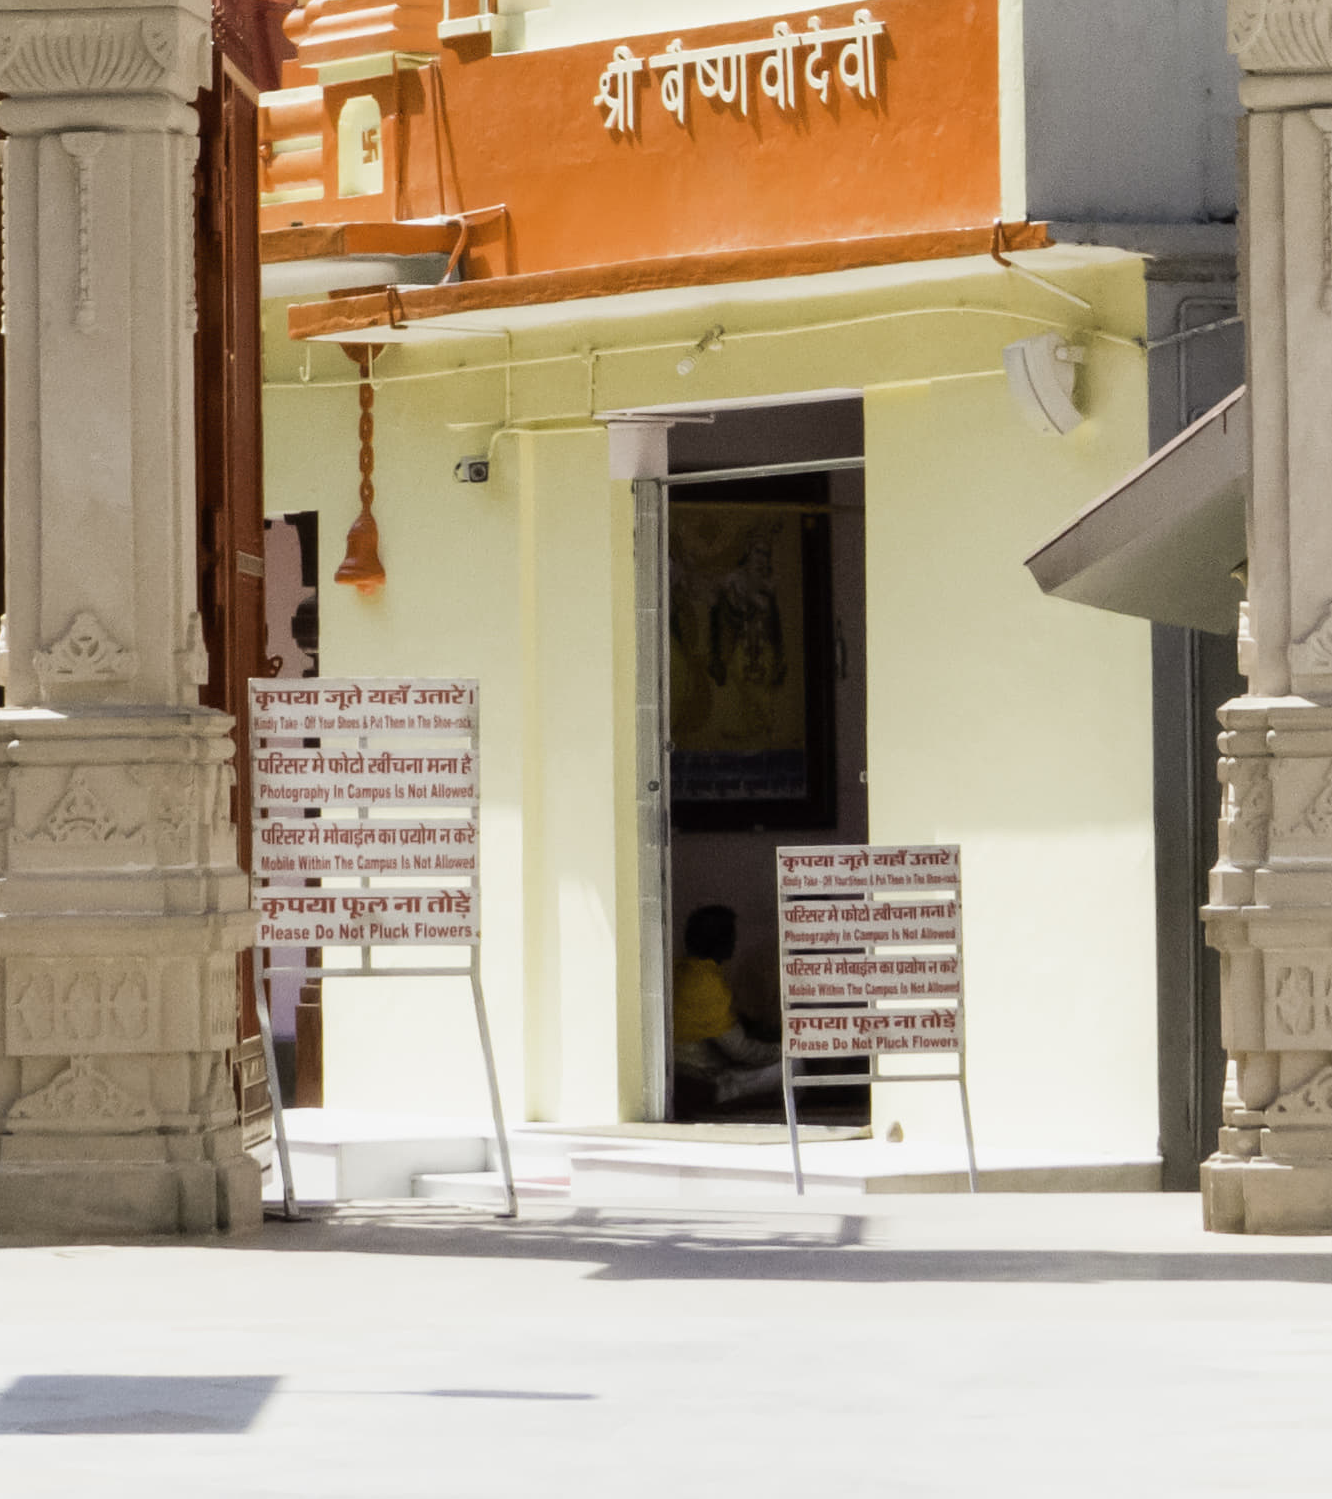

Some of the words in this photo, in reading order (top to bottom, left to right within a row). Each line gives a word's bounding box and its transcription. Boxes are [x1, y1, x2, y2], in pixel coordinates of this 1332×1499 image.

[593, 45, 644, 132] श्री
[254, 690, 320, 711] कृपया
[323, 684, 363, 711] जूते
[280, 715, 298, 729] Take
[385, 715, 406, 729] Them
[417, 715, 431, 729] The
[257, 751, 308, 774] परिसर
[328, 751, 364, 773] फोटो
[426, 758, 458, 773] मना
[461, 752, 472, 774] है
[260, 783, 330, 803] Photography
[334, 783, 344, 798] In
[348, 783, 391, 803] Campus
[395, 783, 404, 798] Is
[408, 783, 427, 798] Not
[431, 783, 474, 798] Allowed
[261, 821, 306, 845] परिसर
[378, 829, 396, 844] का
[400, 822, 436, 846] प्रयोग
[440, 829, 450, 844] न
[261, 855, 295, 870] Mobile
[298, 855, 331, 870] Within
[334, 855, 354, 870] The
[357, 854, 397, 874] Campus
[401, 855, 410, 870] Is
[414, 855, 431, 870] Not
[435, 855, 475, 870] Allowed
[782, 855, 834, 872] कृपया
[838, 850, 868, 871] जूते
[260, 897, 337, 919] कृपया
[342, 897, 389, 919] फूल
[393, 897, 422, 913] ना
[785, 905, 825, 923] परिसर
[841, 904, 870, 922] फोटो
[918, 905, 944, 918] मना
[261, 923, 310, 940] Please
[315, 923, 333, 940] Do
[339, 923, 364, 940] Not
[370, 923, 409, 939] Pluck
[415, 922, 472, 938] Flowers
[785, 930, 839, 944] Photography
[842, 929, 851, 941] In
[854, 929, 889, 943] Campus
[892, 928, 900, 940] Is
[902, 928, 918, 940] Not
[921, 927, 956, 939] Allowed
[786, 959, 821, 976] परिसर
[879, 962, 893, 974] का
[897, 957, 926, 974] प्रयोग
[929, 962, 937, 973] न
[789, 984, 816, 996] Mobile
[847, 983, 862, 996] The
[866, 982, 898, 997] Campus
[901, 982, 908, 994] Is
[911, 981, 925, 993] Not
[928, 980, 960, 992] Allowed
[788, 1016, 847, 1035] कृपया
[853, 1016, 889, 1034] फूल
[894, 1015, 916, 1030] ना
[789, 1037, 829, 1051] Please
[834, 1037, 848, 1050] Do
[852, 1037, 872, 1050] Not
[876, 1036, 908, 1049] Pluck
[913, 1035, 959, 1048] Flowers
